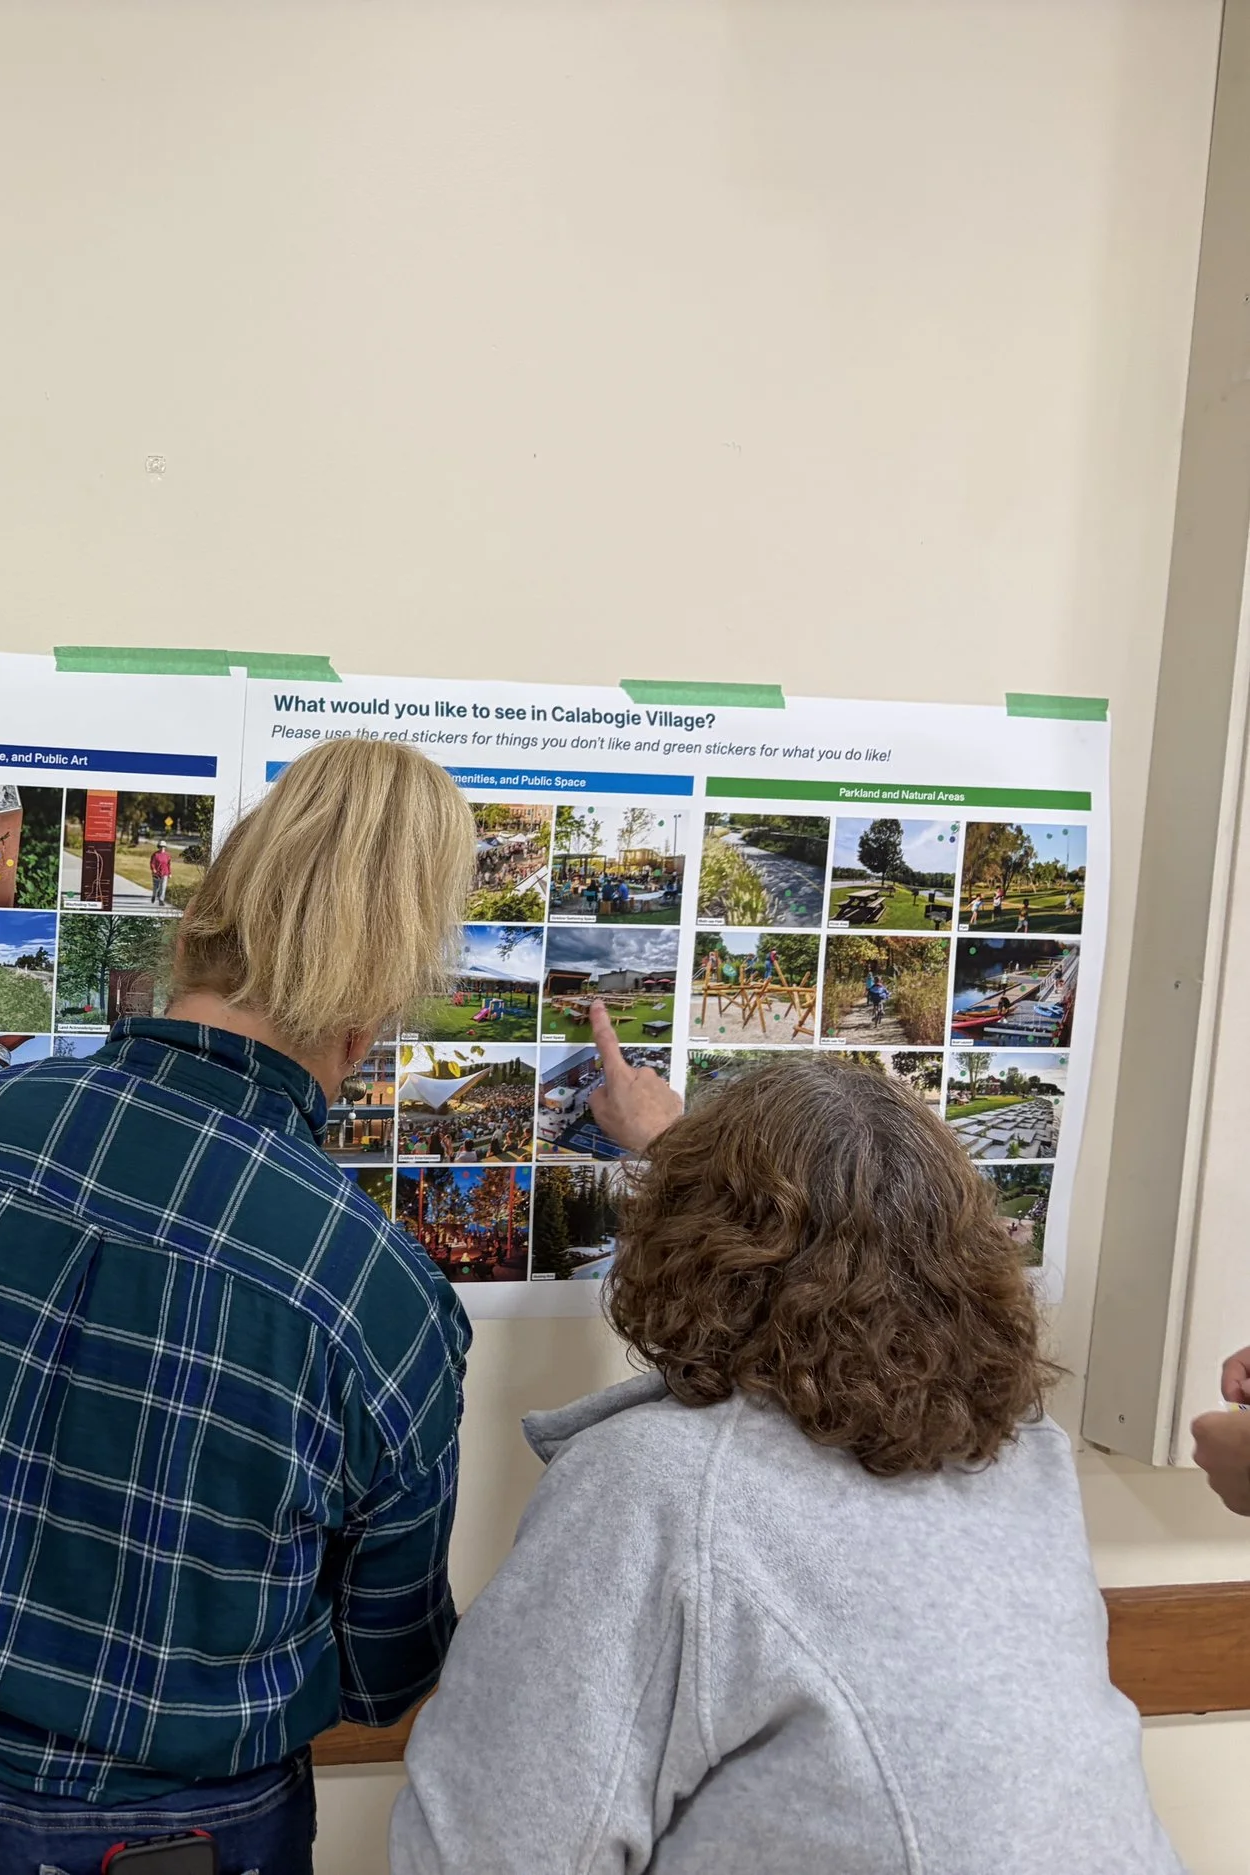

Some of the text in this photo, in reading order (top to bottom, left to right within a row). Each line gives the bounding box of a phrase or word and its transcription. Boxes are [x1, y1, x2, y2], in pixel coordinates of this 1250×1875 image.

[274, 695, 715, 731] What would you like to see in Calabogie Village?
[271, 725, 891, 761] Please use the red stickers for things you don't like and green stickers for what you do like!
[11, 753, 32, 762] and
[35, 753, 68, 764] Public
[71, 755, 87, 765] Art
[452, 774, 586, 788] menities, and Public Space
[840, 788, 965, 801] Parkland and Natural Areas
